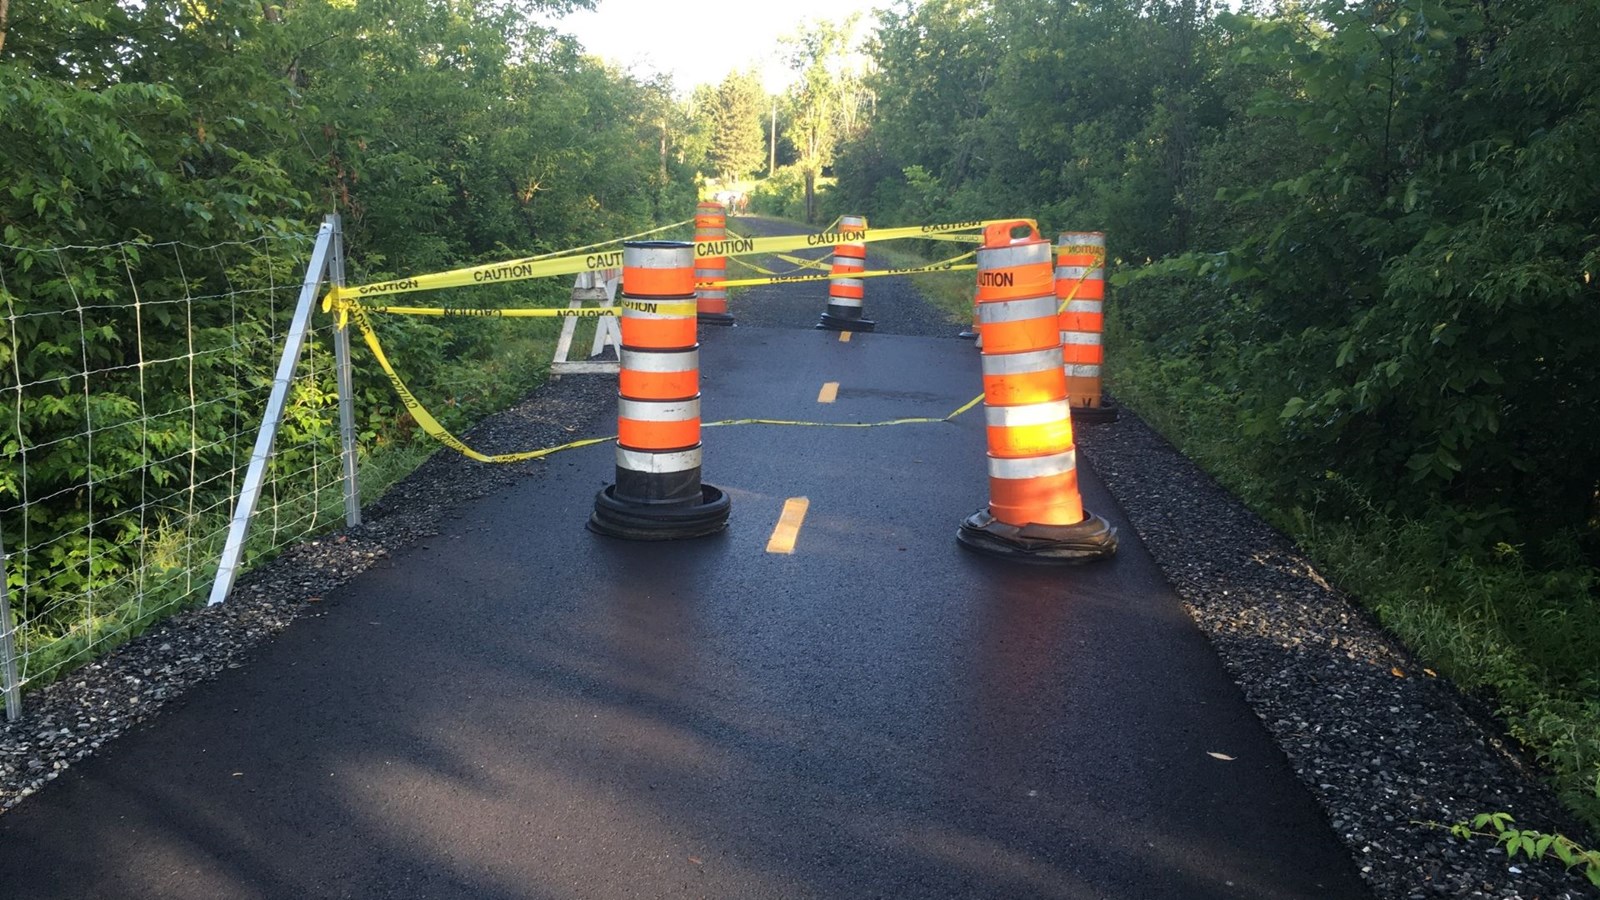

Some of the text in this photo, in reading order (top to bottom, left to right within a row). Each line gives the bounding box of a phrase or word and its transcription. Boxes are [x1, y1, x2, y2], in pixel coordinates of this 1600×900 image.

[359, 280, 418, 294] CAUTION
[474, 264, 532, 282] CAUTION
[697, 239, 753, 257] CAUTION
[807, 231, 865, 246] CAUTION
